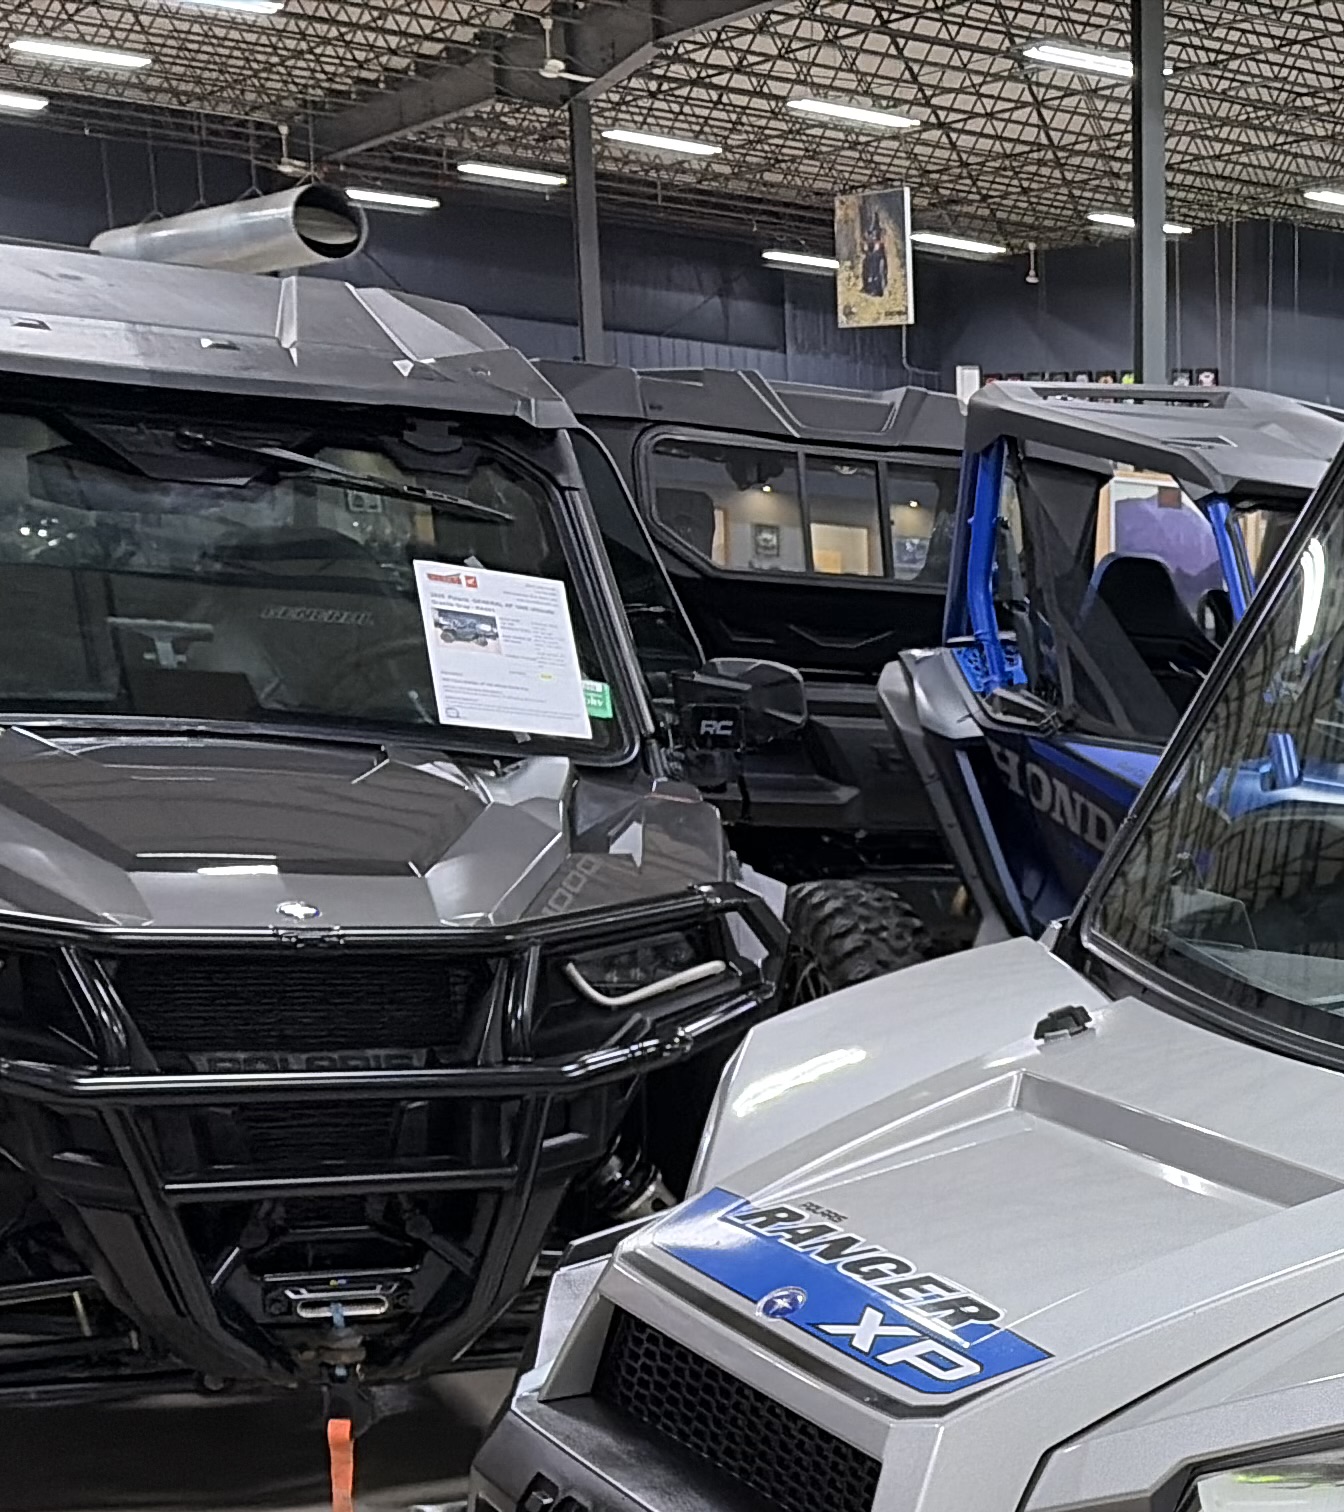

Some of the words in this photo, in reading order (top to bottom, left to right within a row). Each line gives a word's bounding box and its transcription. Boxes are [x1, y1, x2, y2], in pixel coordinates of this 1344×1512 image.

[700, 719, 734, 735] RC
[984, 735, 1119, 853] HOND
[729, 1203, 1007, 1332] RANGER
[812, 1306, 984, 1383] XP
